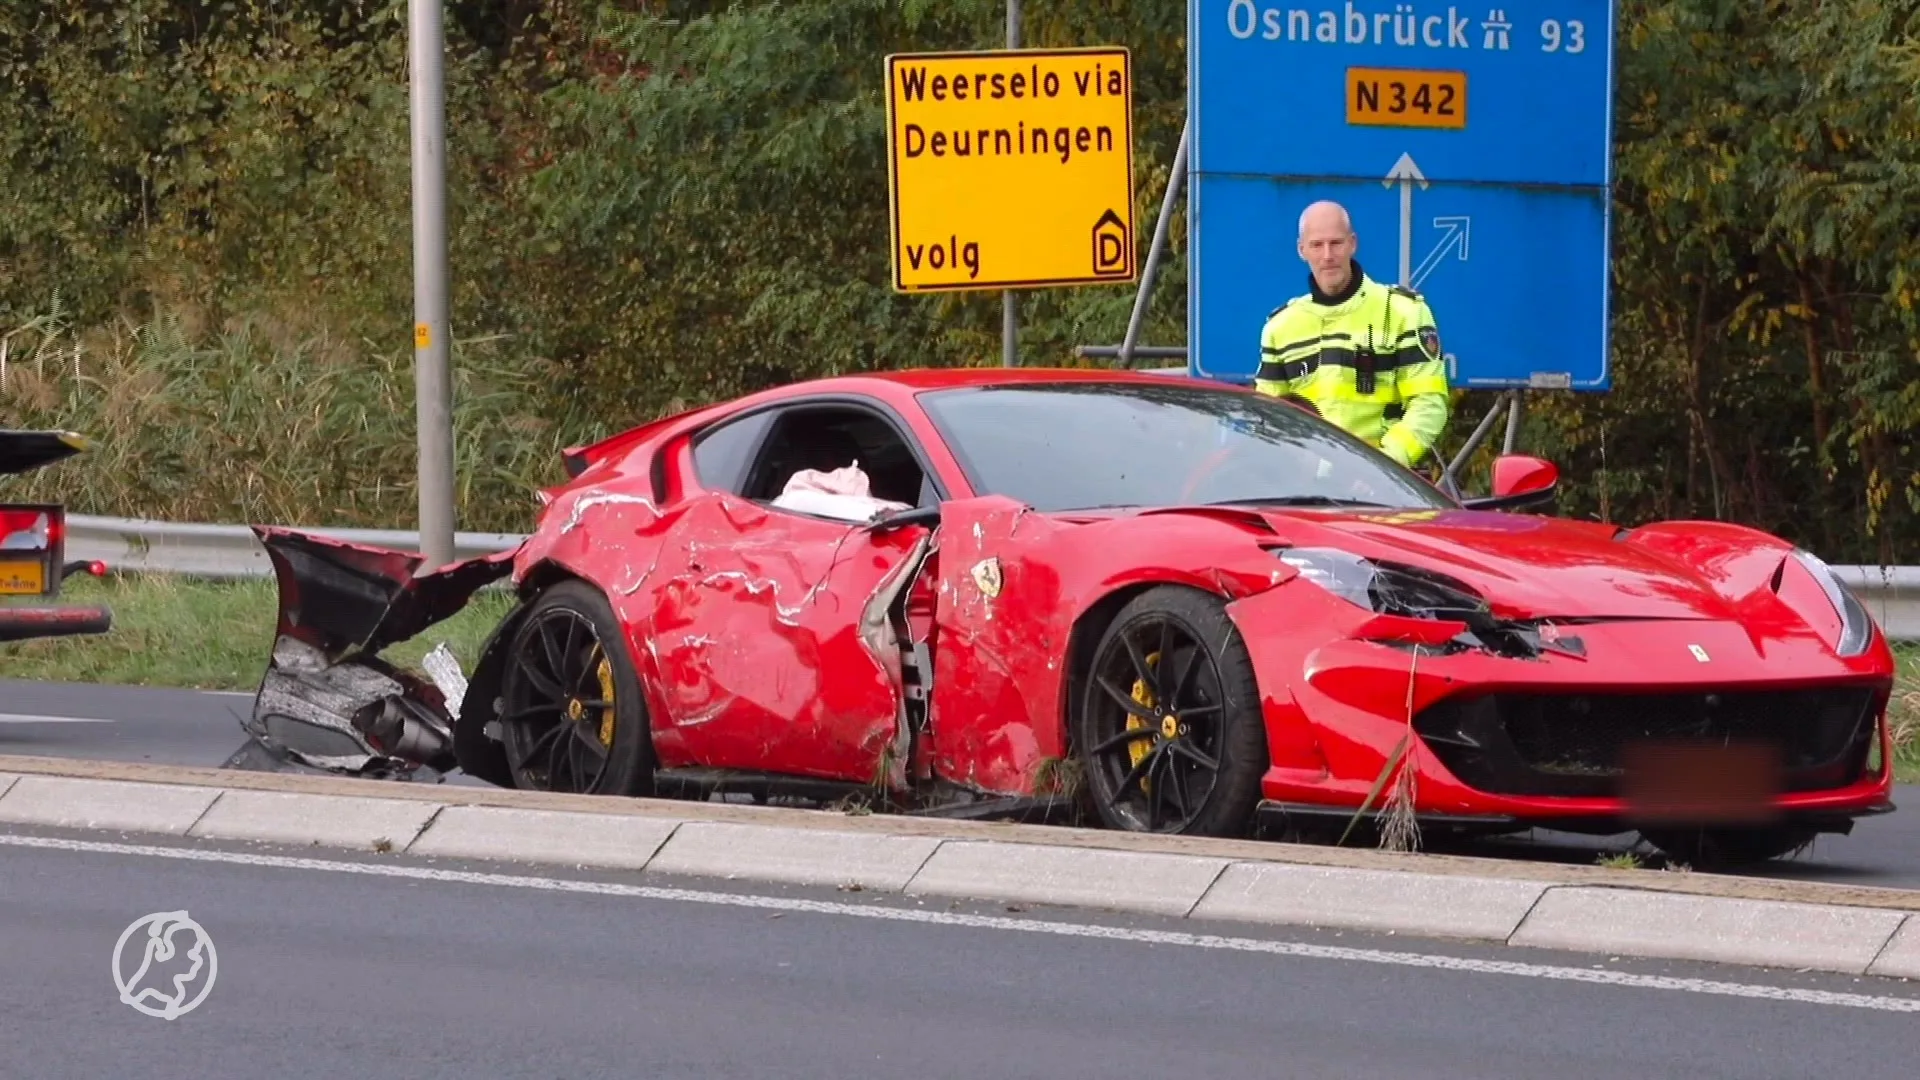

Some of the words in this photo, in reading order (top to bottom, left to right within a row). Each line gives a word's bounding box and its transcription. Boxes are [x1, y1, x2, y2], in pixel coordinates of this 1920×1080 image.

[1226, 0, 1470, 48] Osnabrück
[1540, 19, 1586, 53] 93
[901, 64, 1059, 101] Weerselo
[1074, 63, 1122, 96] via
[905, 121, 1113, 164] Deurningen
[906, 234, 979, 280] volg
[1099, 233, 1122, 266] D
